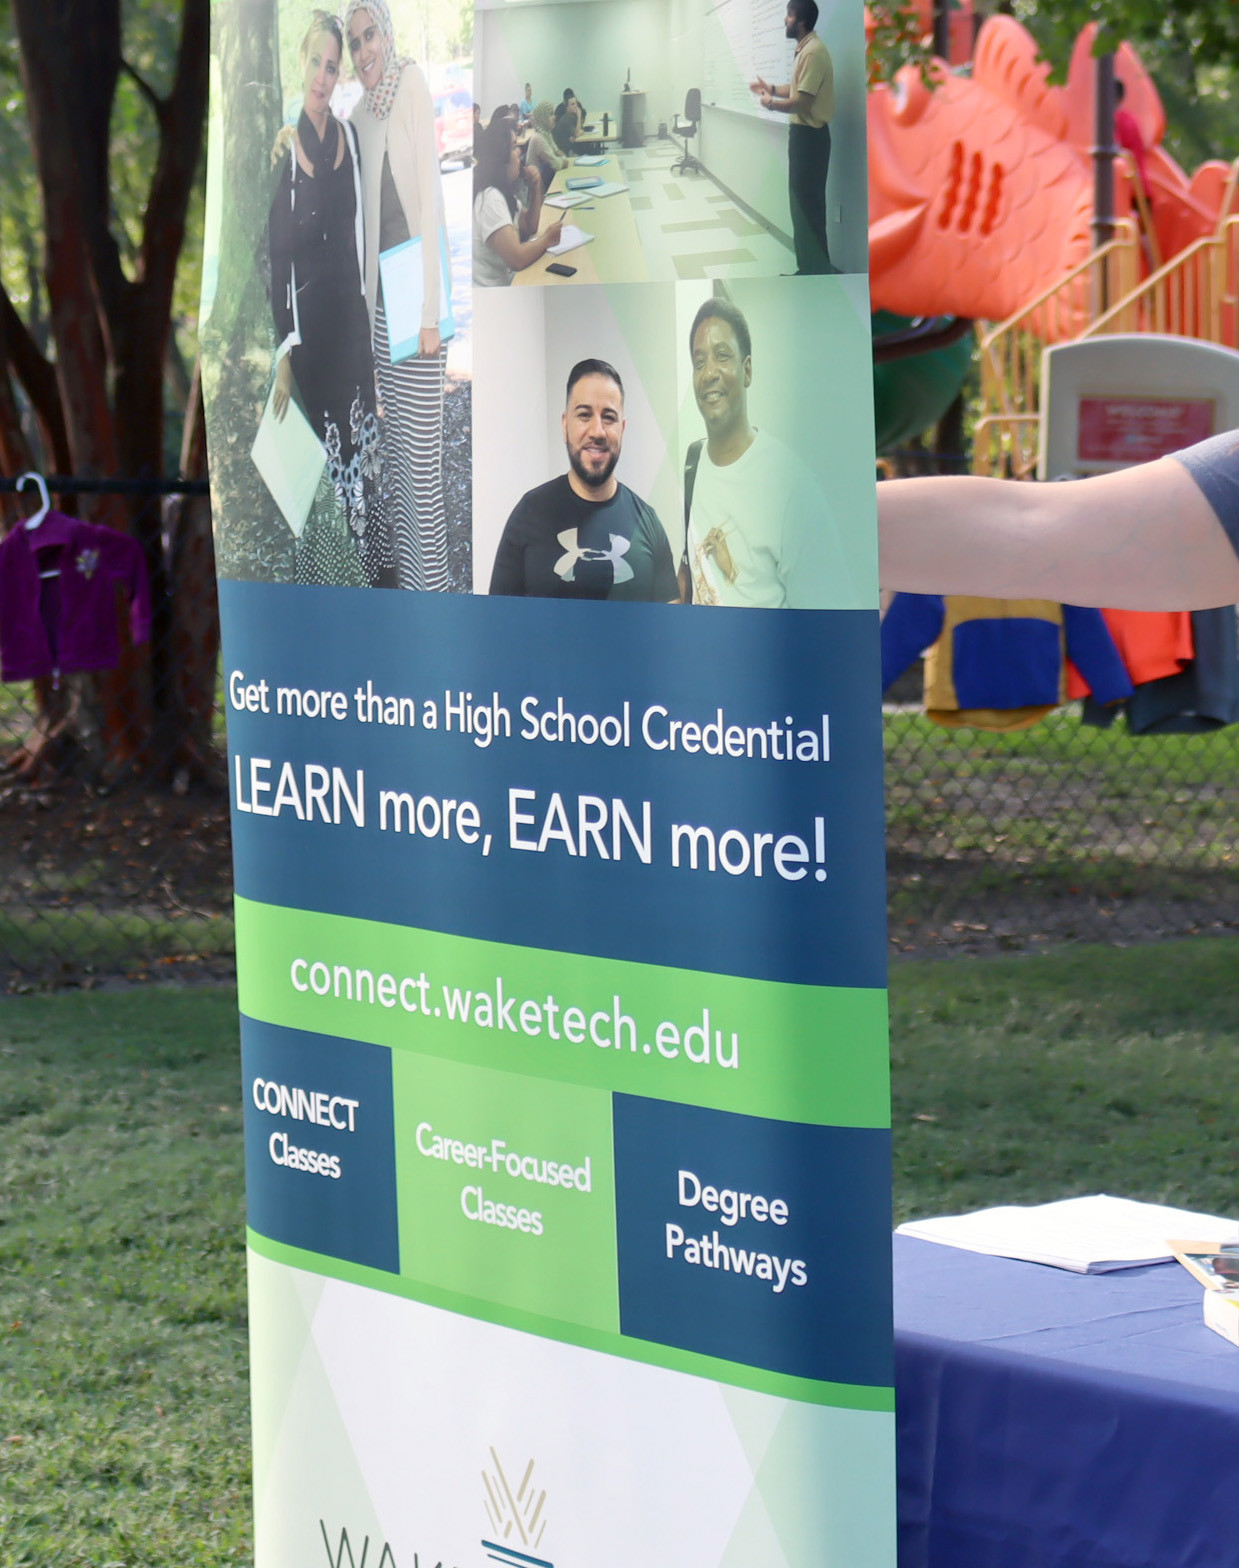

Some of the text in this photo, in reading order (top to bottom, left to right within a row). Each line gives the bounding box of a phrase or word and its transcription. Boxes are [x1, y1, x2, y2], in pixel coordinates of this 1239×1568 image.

[229, 671, 832, 762] Get more than a High School Credential
[234, 754, 828, 882] LEARN more, EARN more!
[290, 958, 740, 1069] connect.waketech.edu
[252, 1077, 359, 1132] CONNECT
[268, 1132, 341, 1180] Classes
[416, 1121, 592, 1194] Career-Focused
[460, 1185, 544, 1236] Classes
[677, 1169, 789, 1228] Degree
[665, 1223, 808, 1294] Pathways
